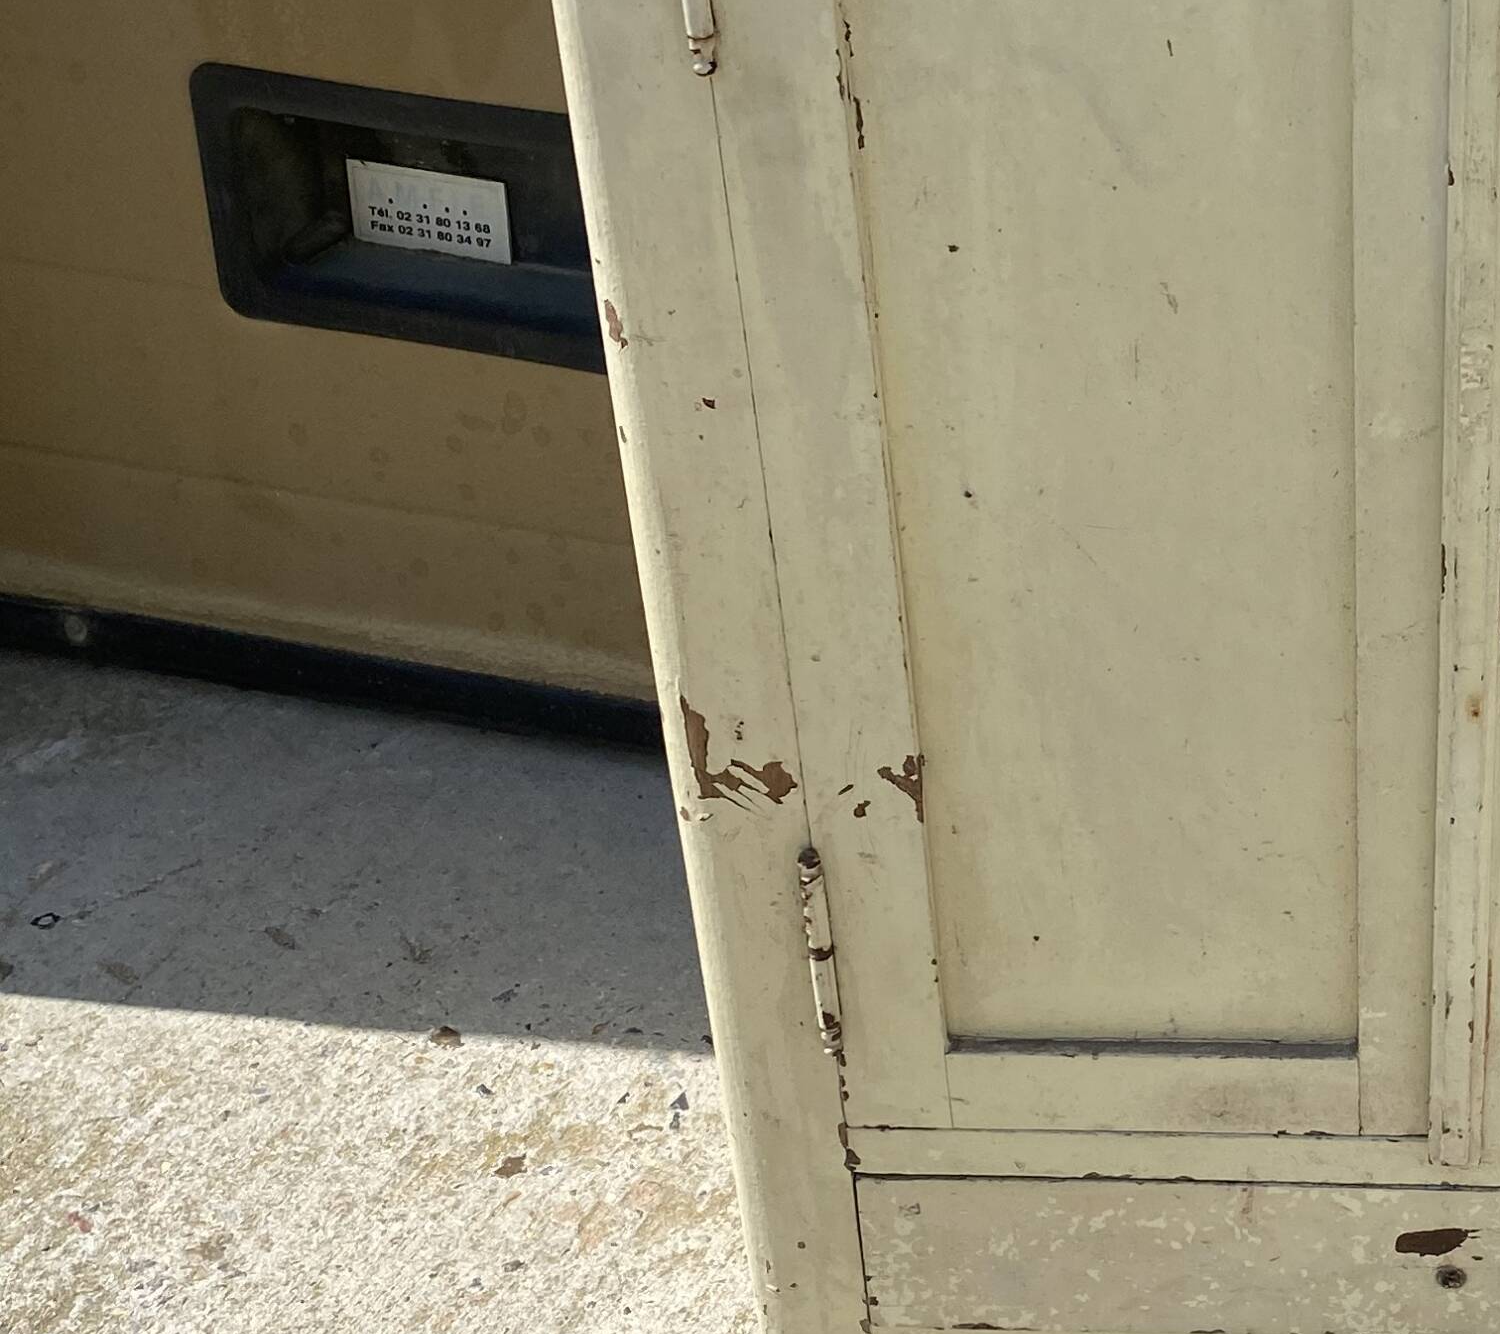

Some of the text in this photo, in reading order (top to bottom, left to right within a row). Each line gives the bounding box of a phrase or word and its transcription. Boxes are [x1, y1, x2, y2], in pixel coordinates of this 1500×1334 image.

[368, 206, 491, 234] Tél. 02 31 80 13 68
[370, 220, 491, 248] Fax 02 31 80 34 97
